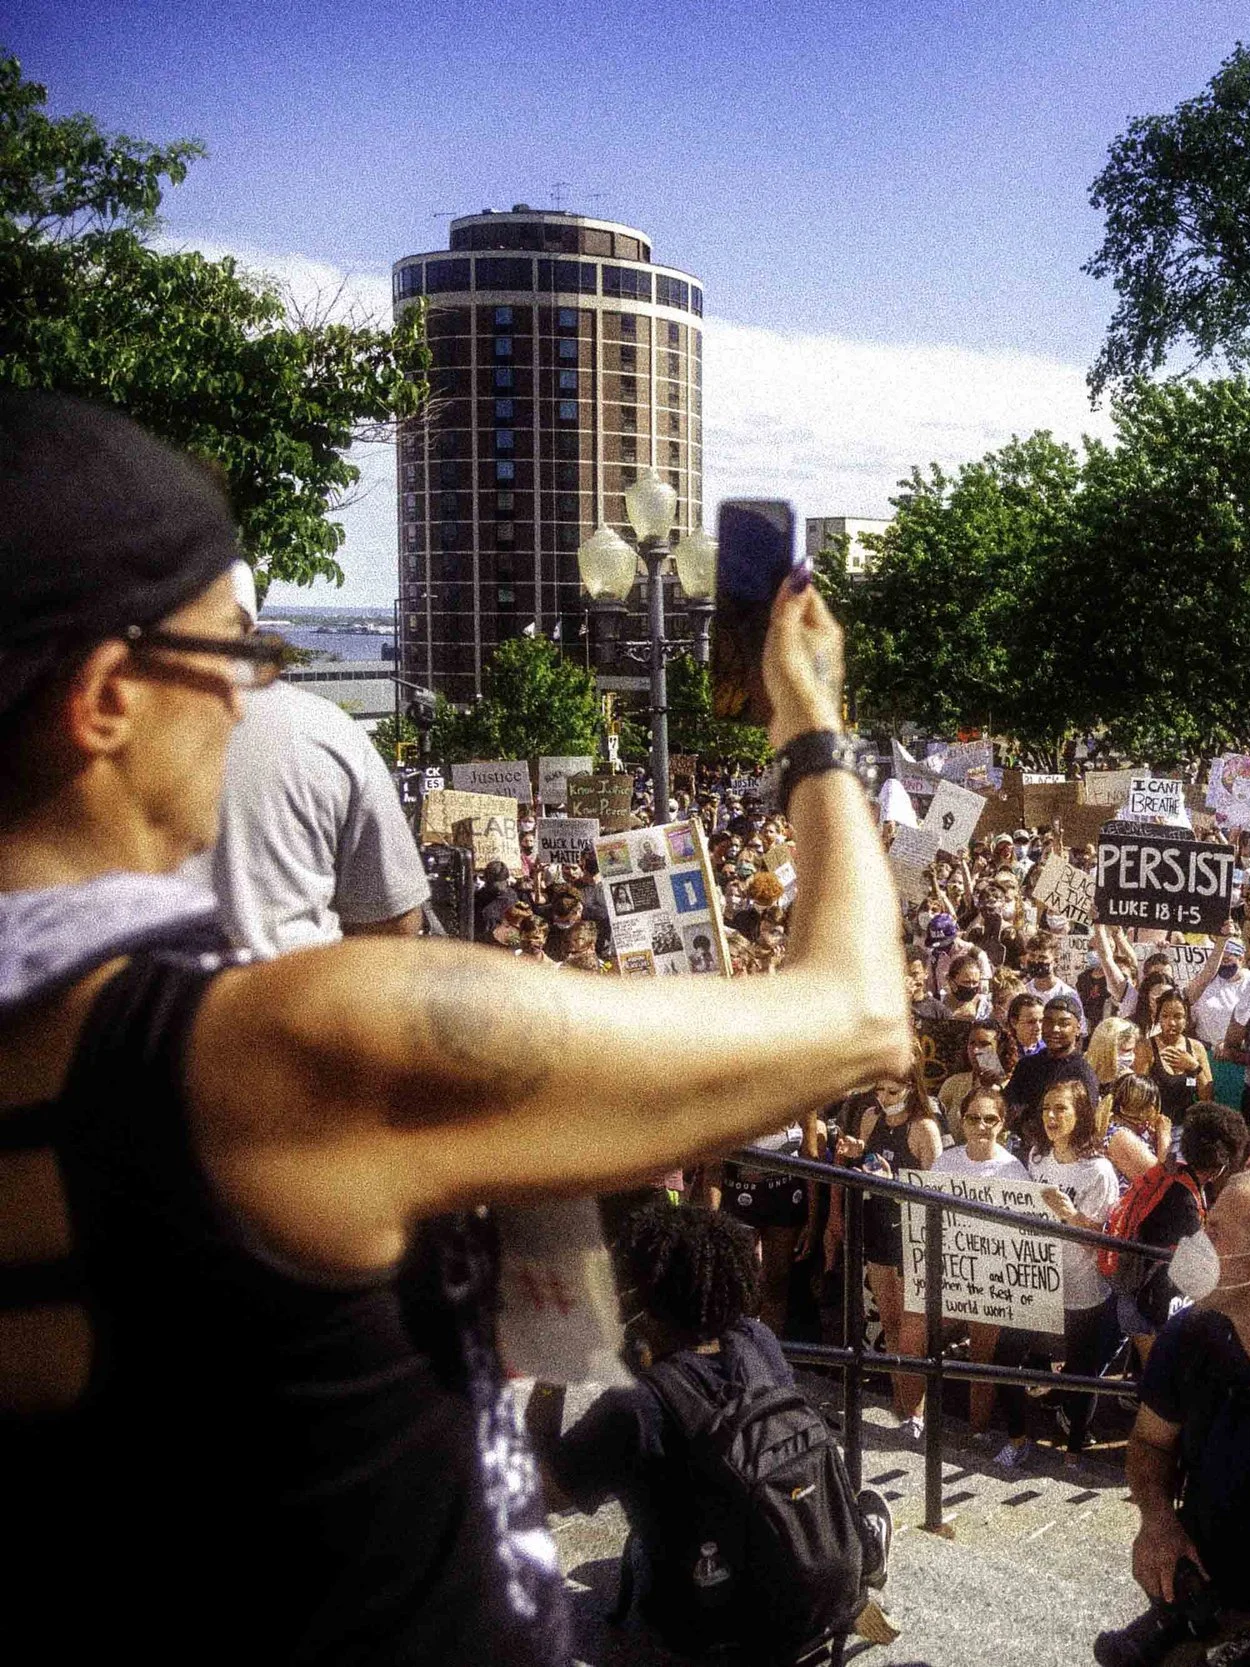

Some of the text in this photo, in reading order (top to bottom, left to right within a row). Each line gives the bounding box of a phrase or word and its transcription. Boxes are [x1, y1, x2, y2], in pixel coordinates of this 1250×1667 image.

[470, 770, 522, 784] Justice
[1132, 780, 1146, 791] I
[1131, 792, 1181, 815] BREATHE
[1060, 864, 1096, 898] BLAC
[1098, 844, 1235, 898] PERSIST
[1054, 880, 1092, 911] LIVE
[1109, 900, 1149, 917] LUKE
[950, 1178, 994, 1204] black
[1001, 1188, 1036, 1209] men,
[912, 1247, 1061, 1293] PTECT and DEFEND
[966, 1281, 985, 1296] the
